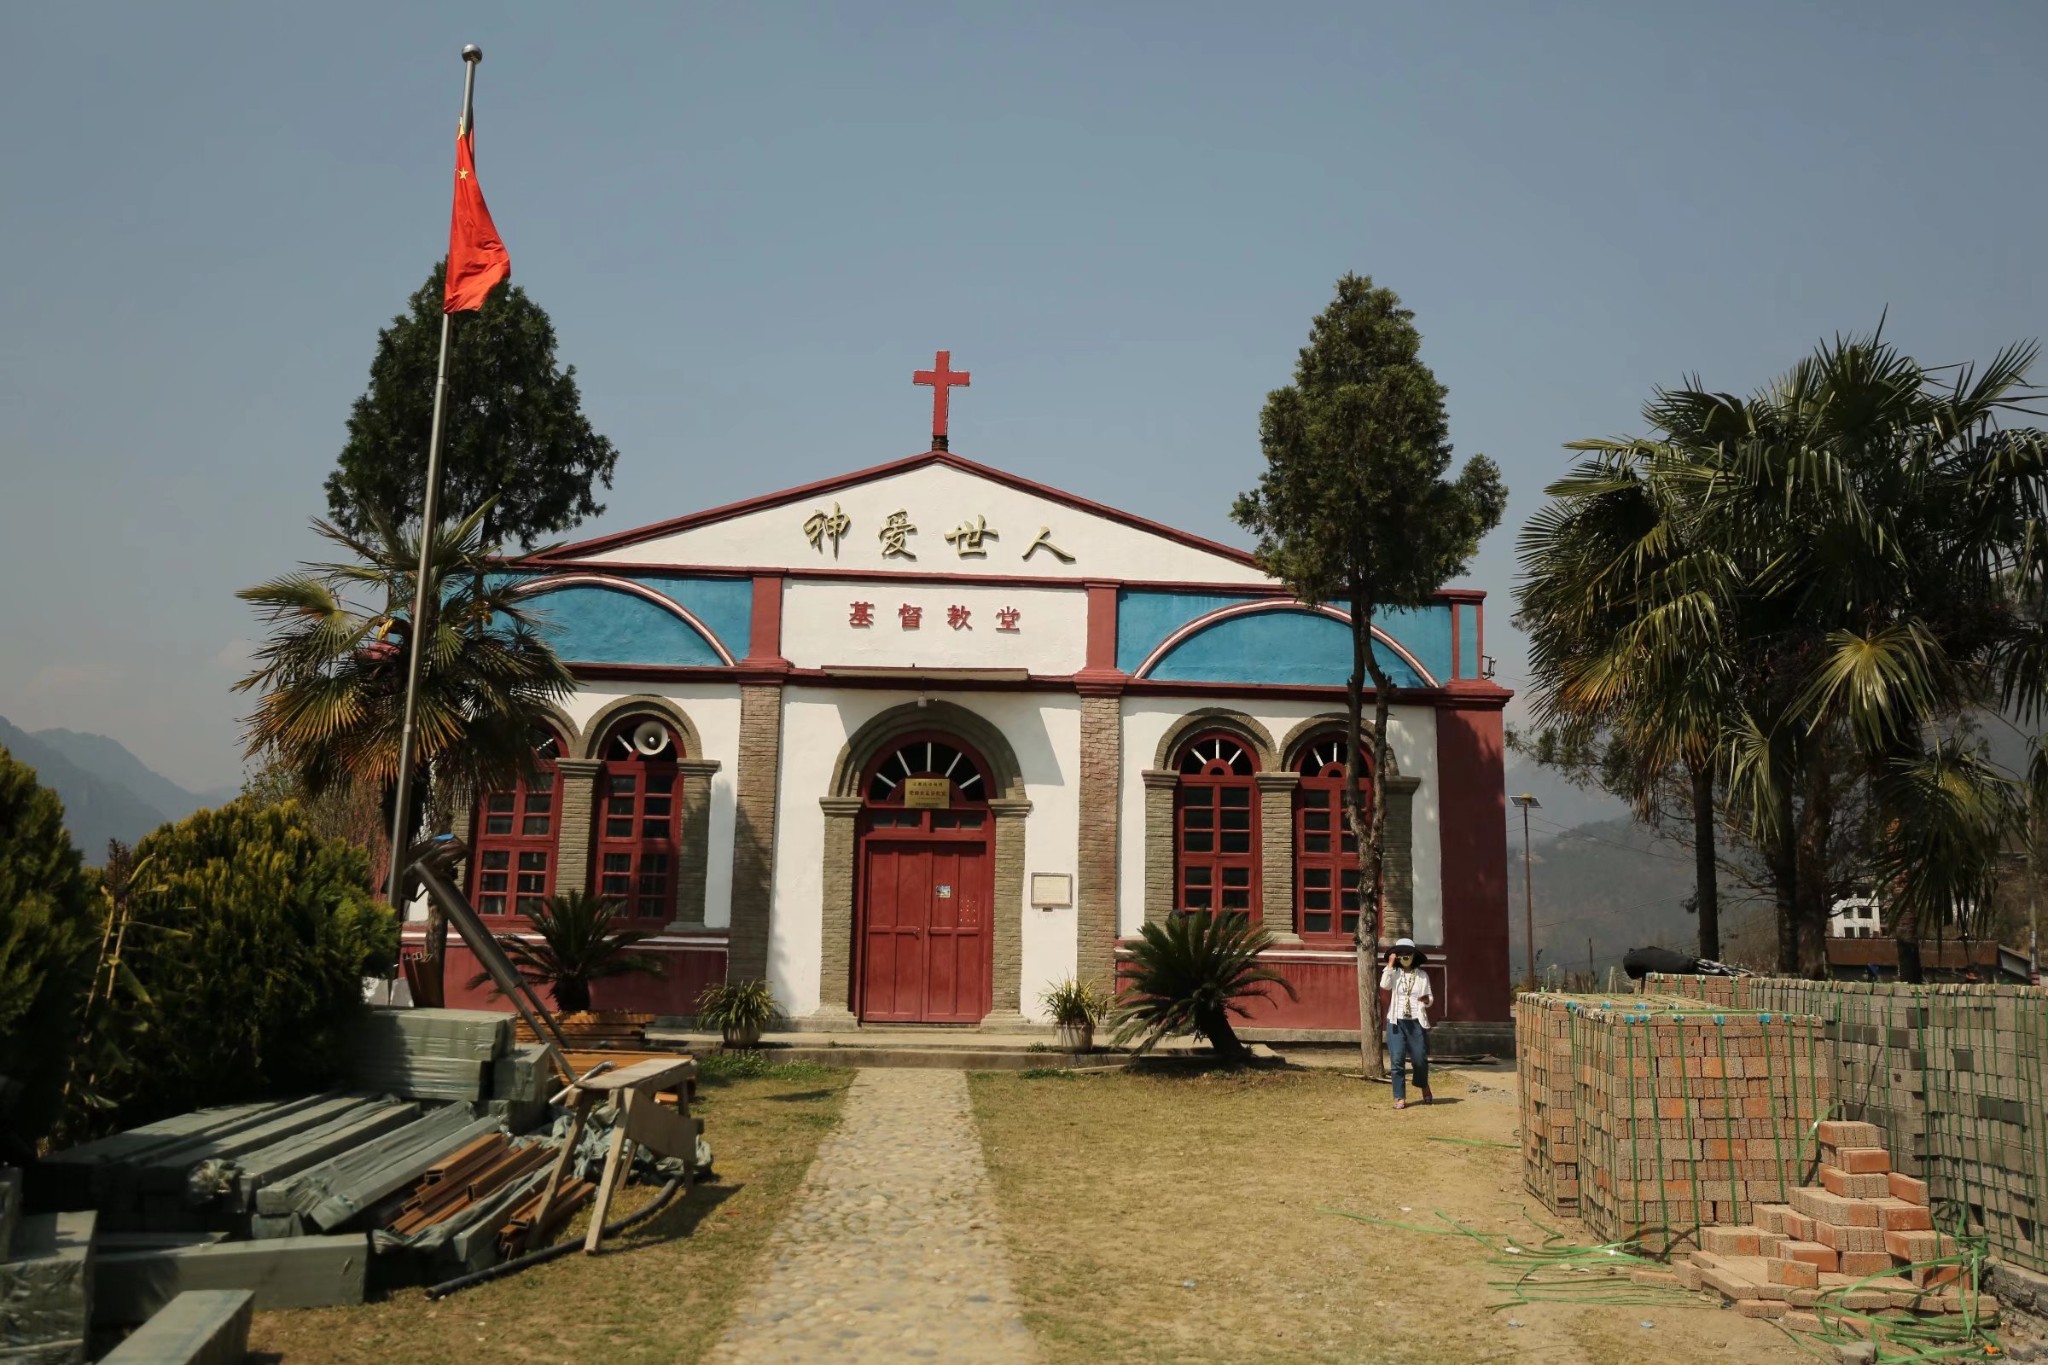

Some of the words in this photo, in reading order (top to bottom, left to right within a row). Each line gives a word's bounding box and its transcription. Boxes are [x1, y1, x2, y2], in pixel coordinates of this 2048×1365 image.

[803, 501, 1076, 562] 神爱世人
[849, 601, 1021, 632] 基督教堂
